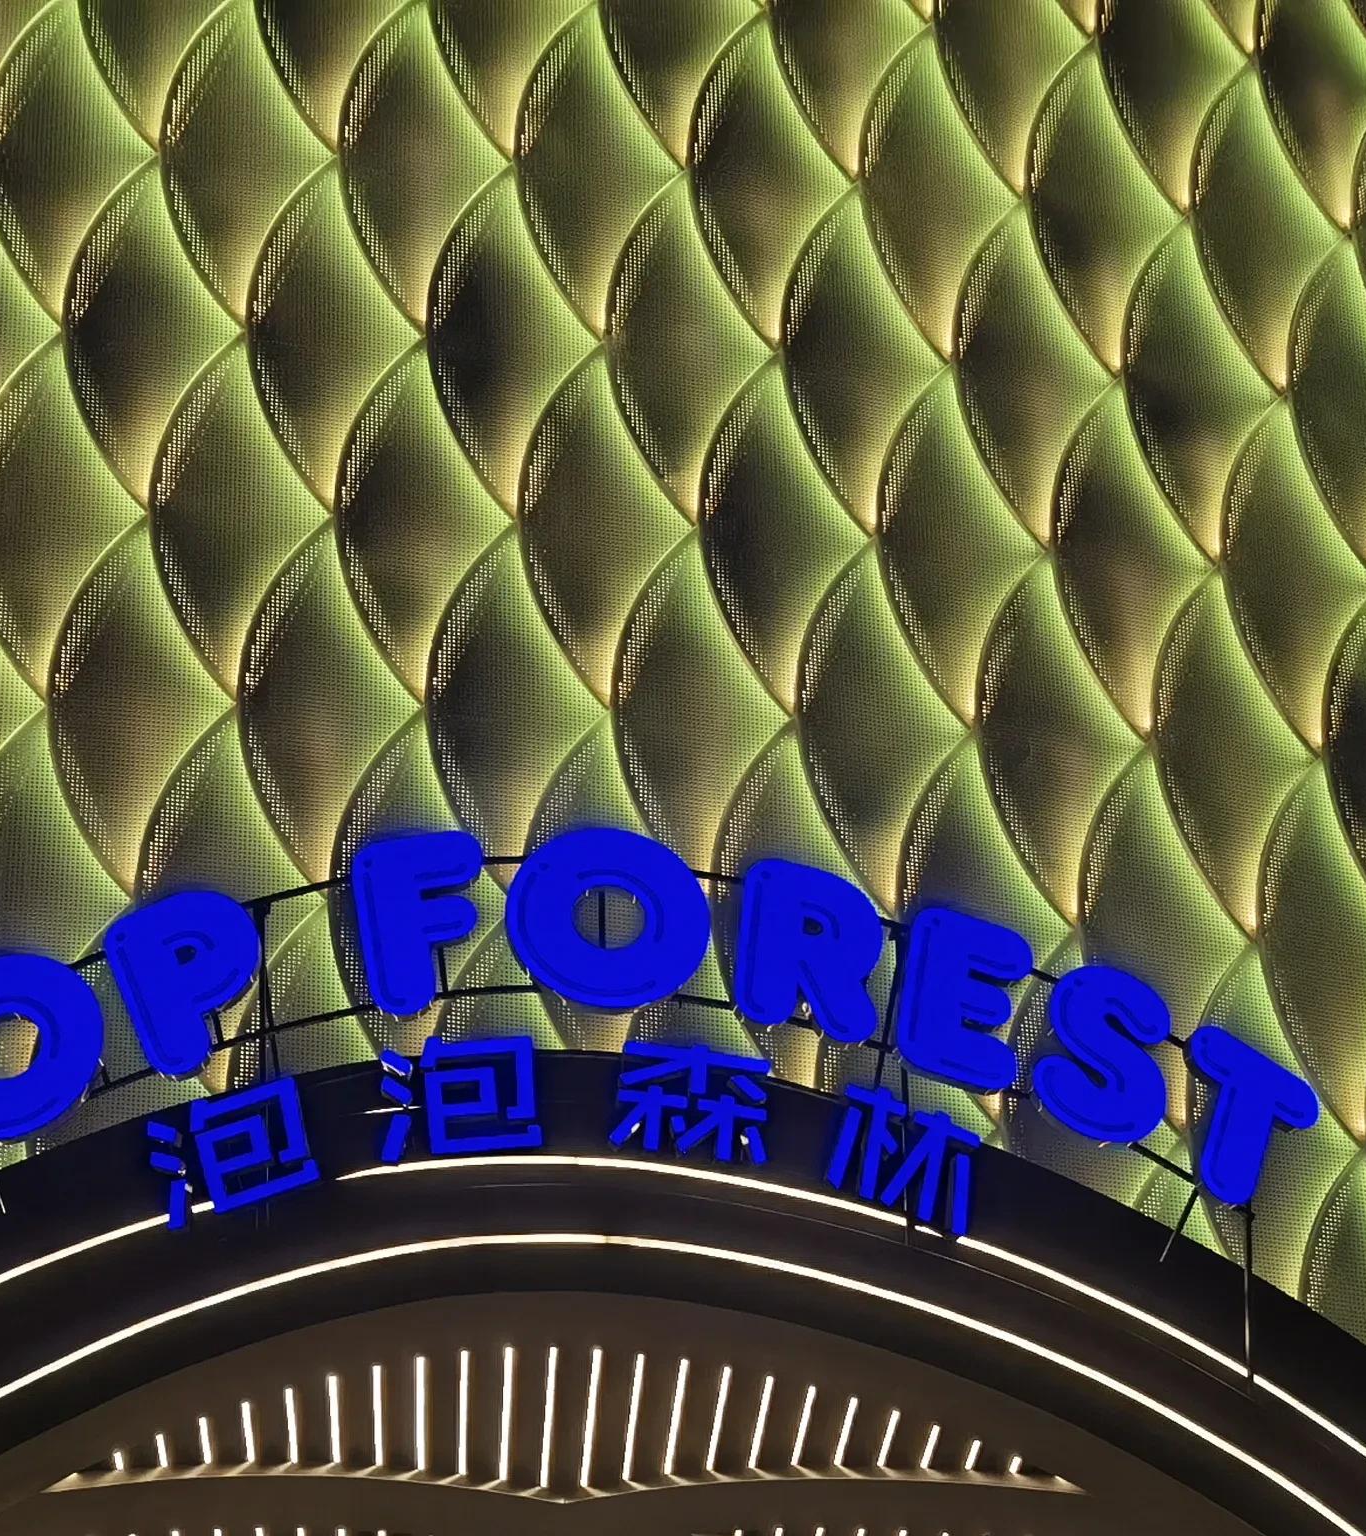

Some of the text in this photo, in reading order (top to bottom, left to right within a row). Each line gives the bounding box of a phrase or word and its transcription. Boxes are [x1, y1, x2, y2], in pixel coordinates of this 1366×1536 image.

[146, 1034, 983, 1236] 泡泡森林
[351, 825, 1321, 1207] FOREST
